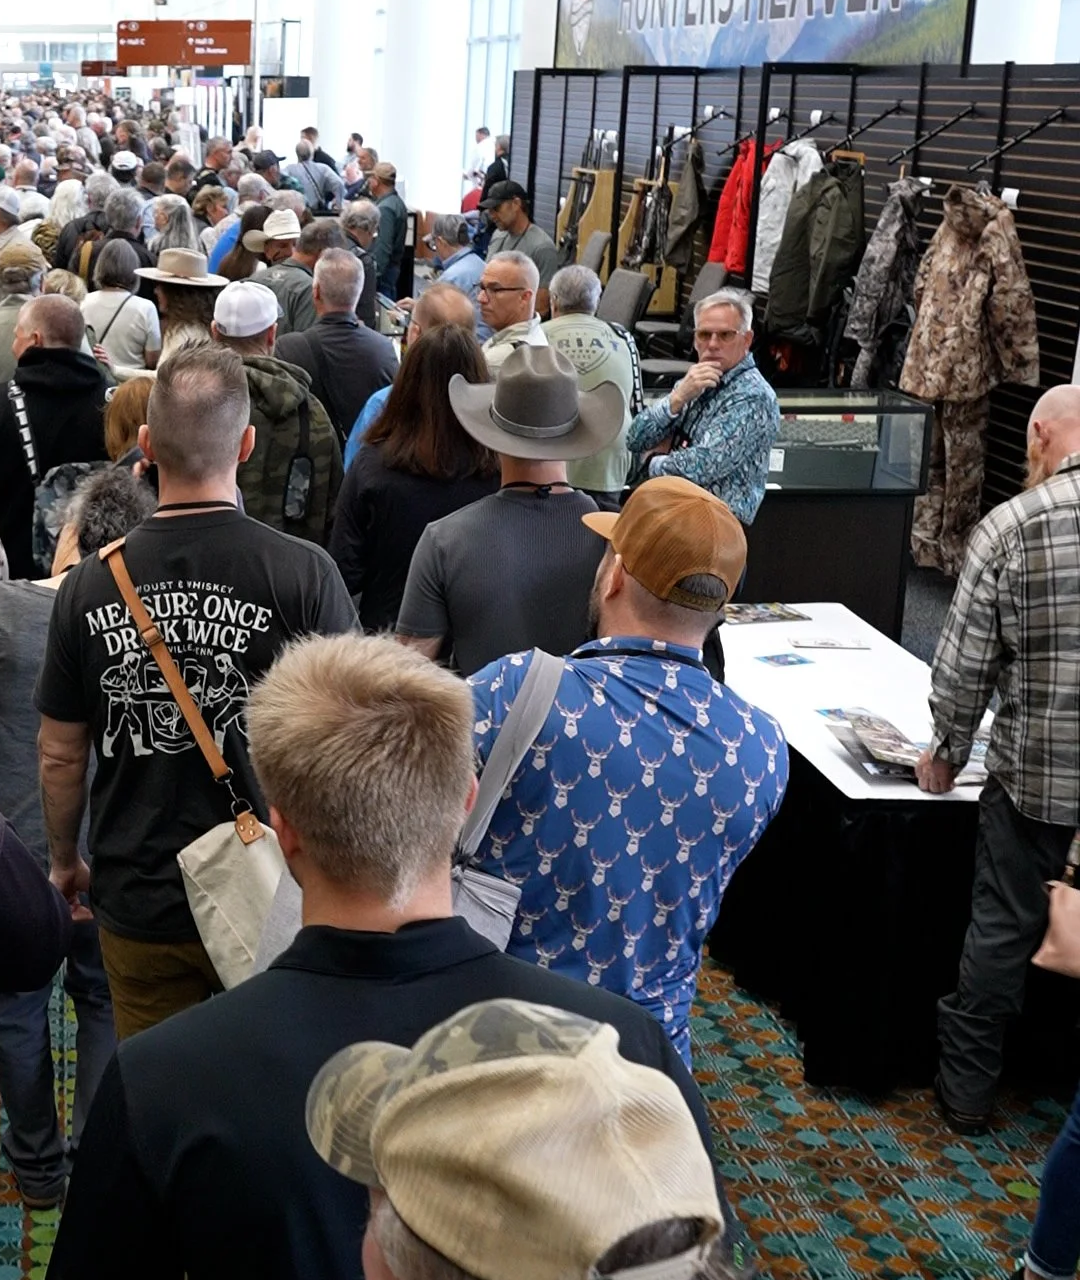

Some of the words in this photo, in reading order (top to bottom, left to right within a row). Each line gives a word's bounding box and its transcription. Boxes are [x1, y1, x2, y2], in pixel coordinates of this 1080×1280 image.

[557, 337, 619, 351] RIAT
[203, 595, 273, 632] ONCE
[103, 619, 181, 656] DRK
[183, 618, 251, 654] TWICE
